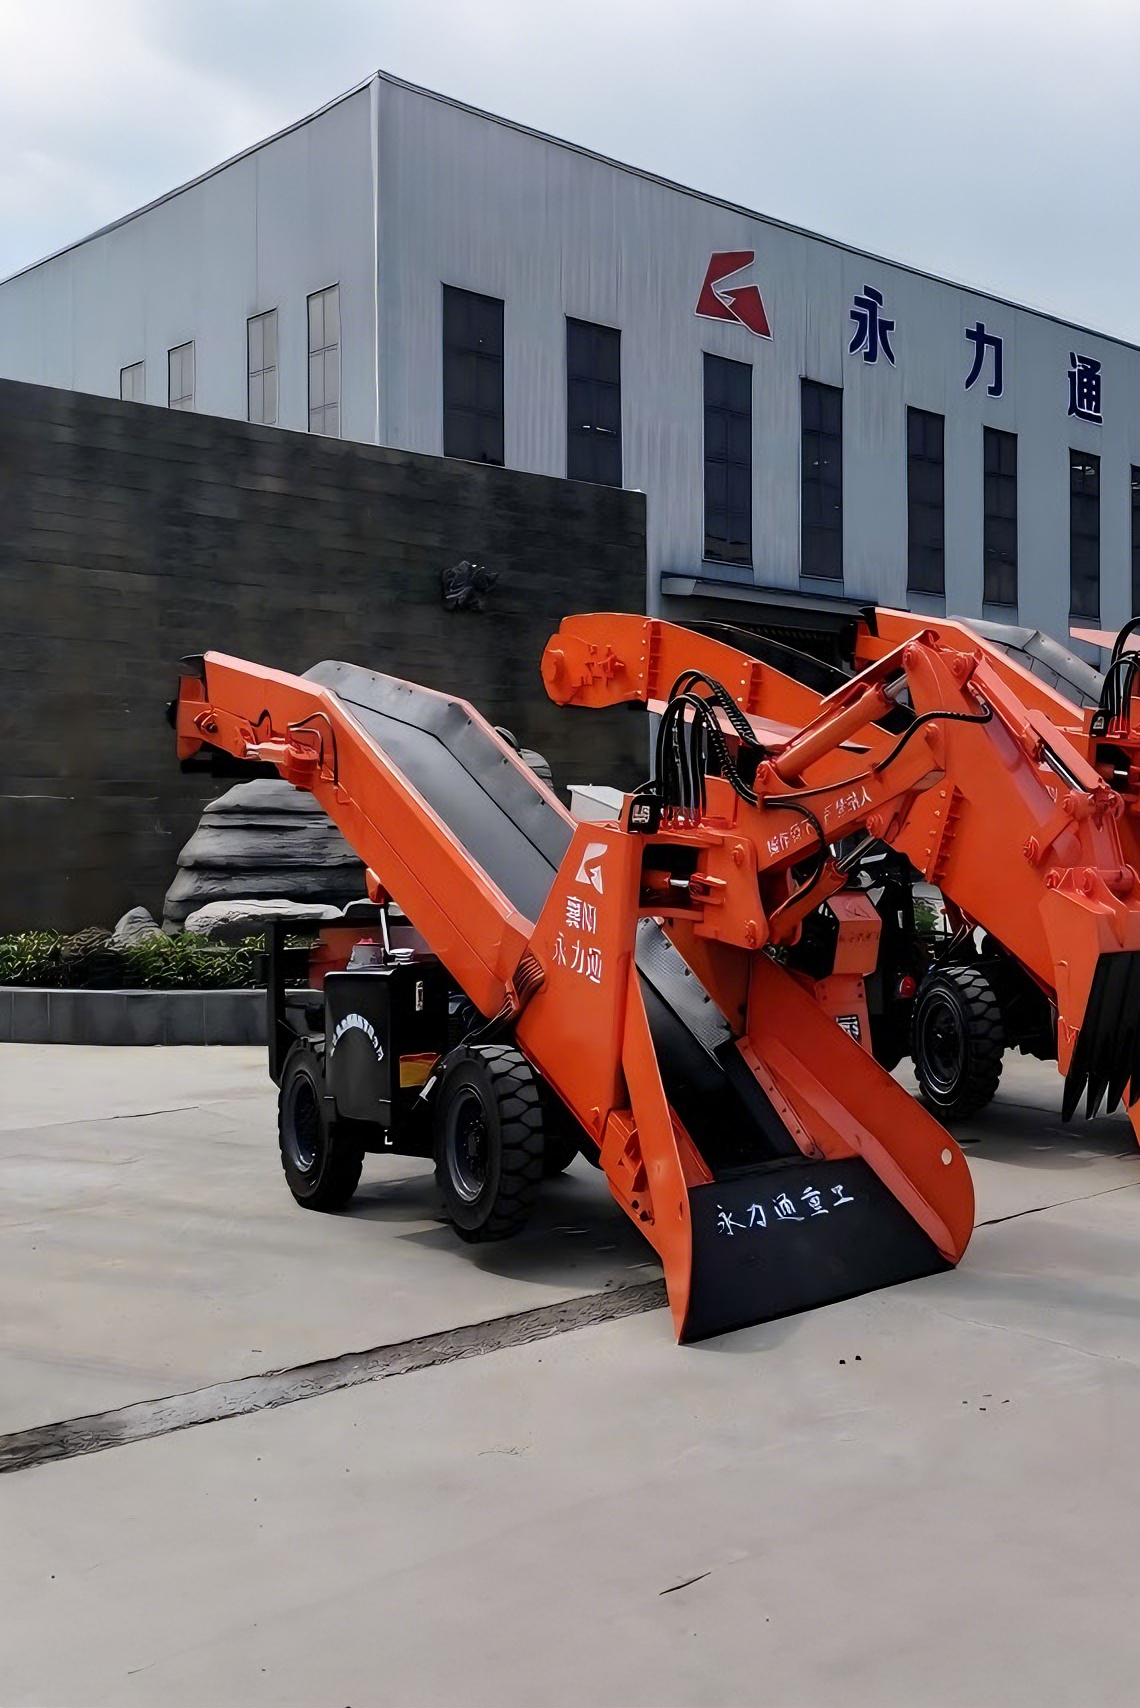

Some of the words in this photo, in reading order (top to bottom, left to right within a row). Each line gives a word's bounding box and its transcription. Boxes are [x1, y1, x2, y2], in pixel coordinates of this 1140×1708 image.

[716, 1184, 855, 1236] 永力通重工
